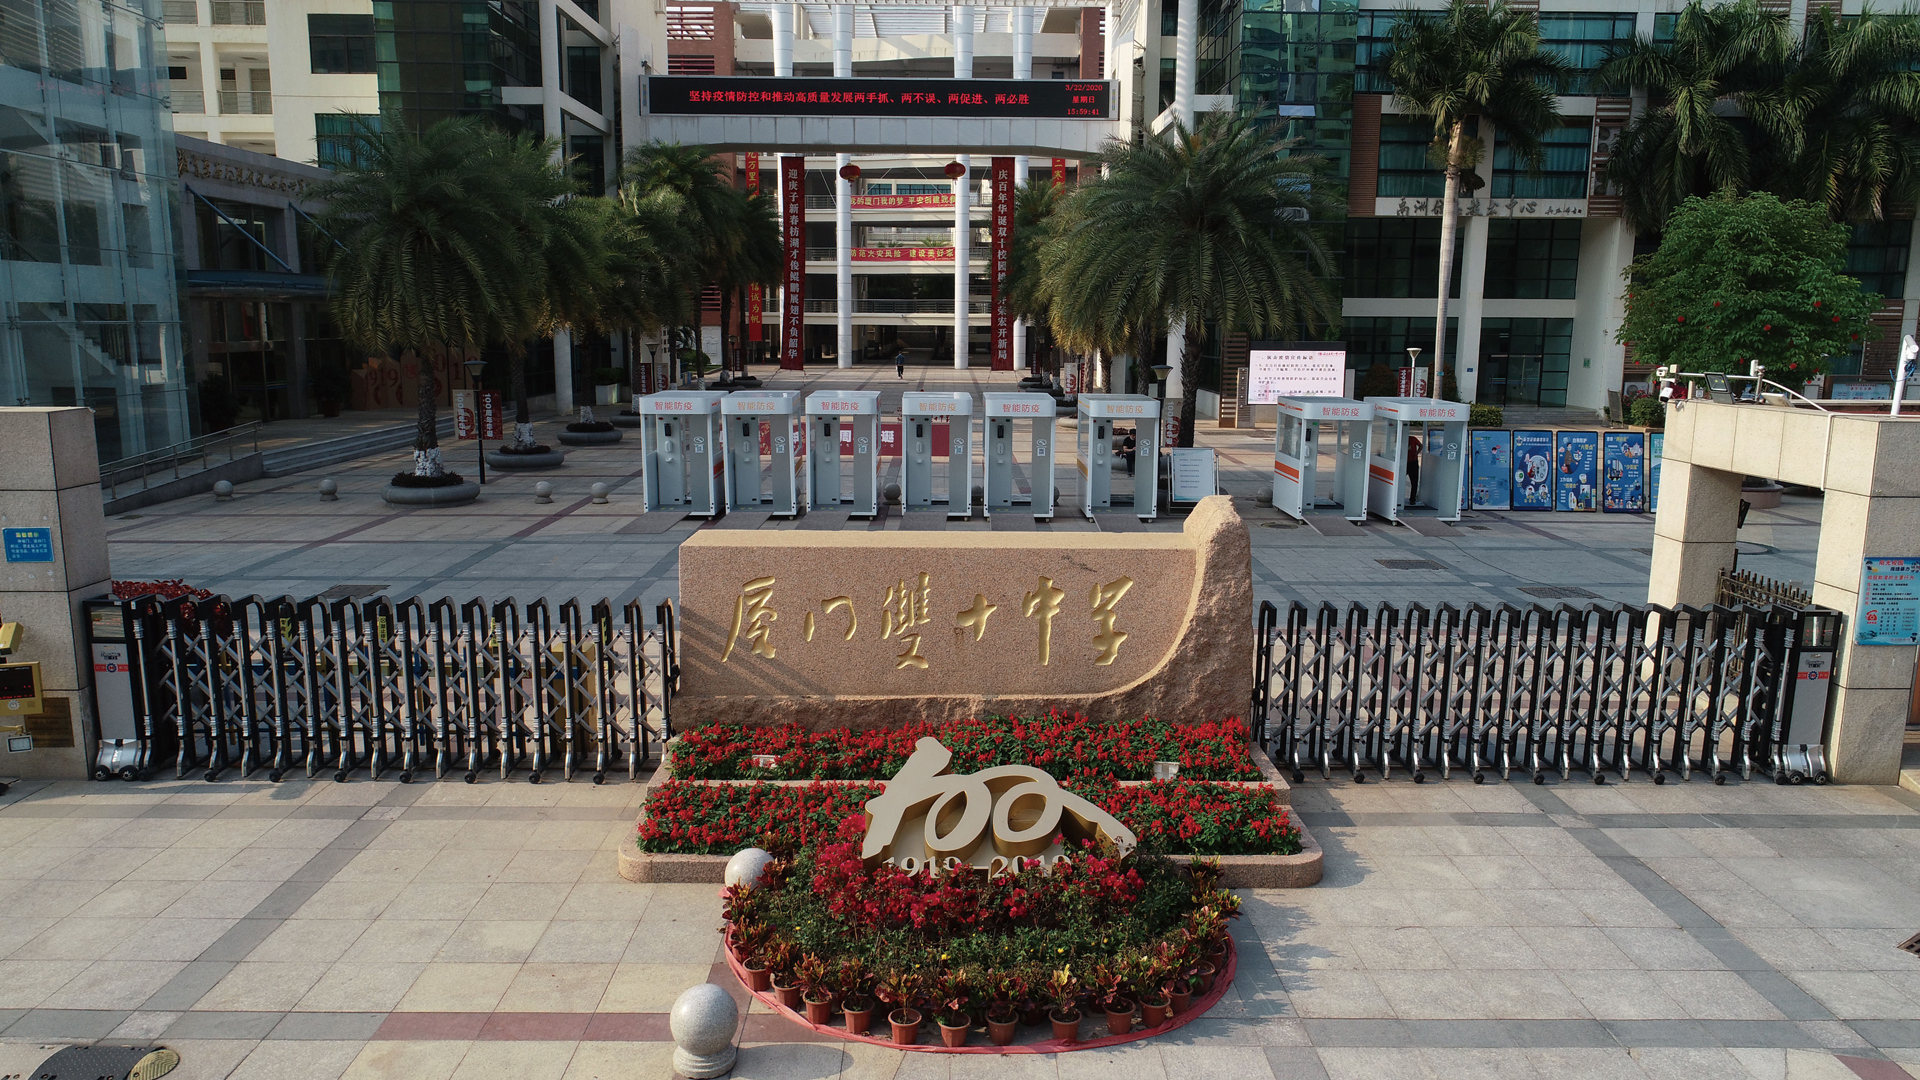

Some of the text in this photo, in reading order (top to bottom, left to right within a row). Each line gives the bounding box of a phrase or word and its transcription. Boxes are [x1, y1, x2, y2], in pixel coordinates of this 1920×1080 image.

[1065, 84, 1103, 92] 3/22/2020
[689, 90, 1030, 105] 坚持疫情防控和推动高质量发展两手抓、两不误、两促进、两必胜
[1072, 95, 1096, 104] 星期日
[1067, 108, 1100, 116] 15:59:41
[654, 401, 693, 411] 智能防疫
[737, 401, 776, 411] 智能防疫
[821, 401, 860, 411] 智能防疫
[918, 402, 957, 412] 智能防疫
[1002, 403, 1041, 414] 智能防疫
[1106, 404, 1144, 414] 智能防疫
[1321, 406, 1360, 418] 智能防疫
[1418, 407, 1457, 418] 智能防疫
